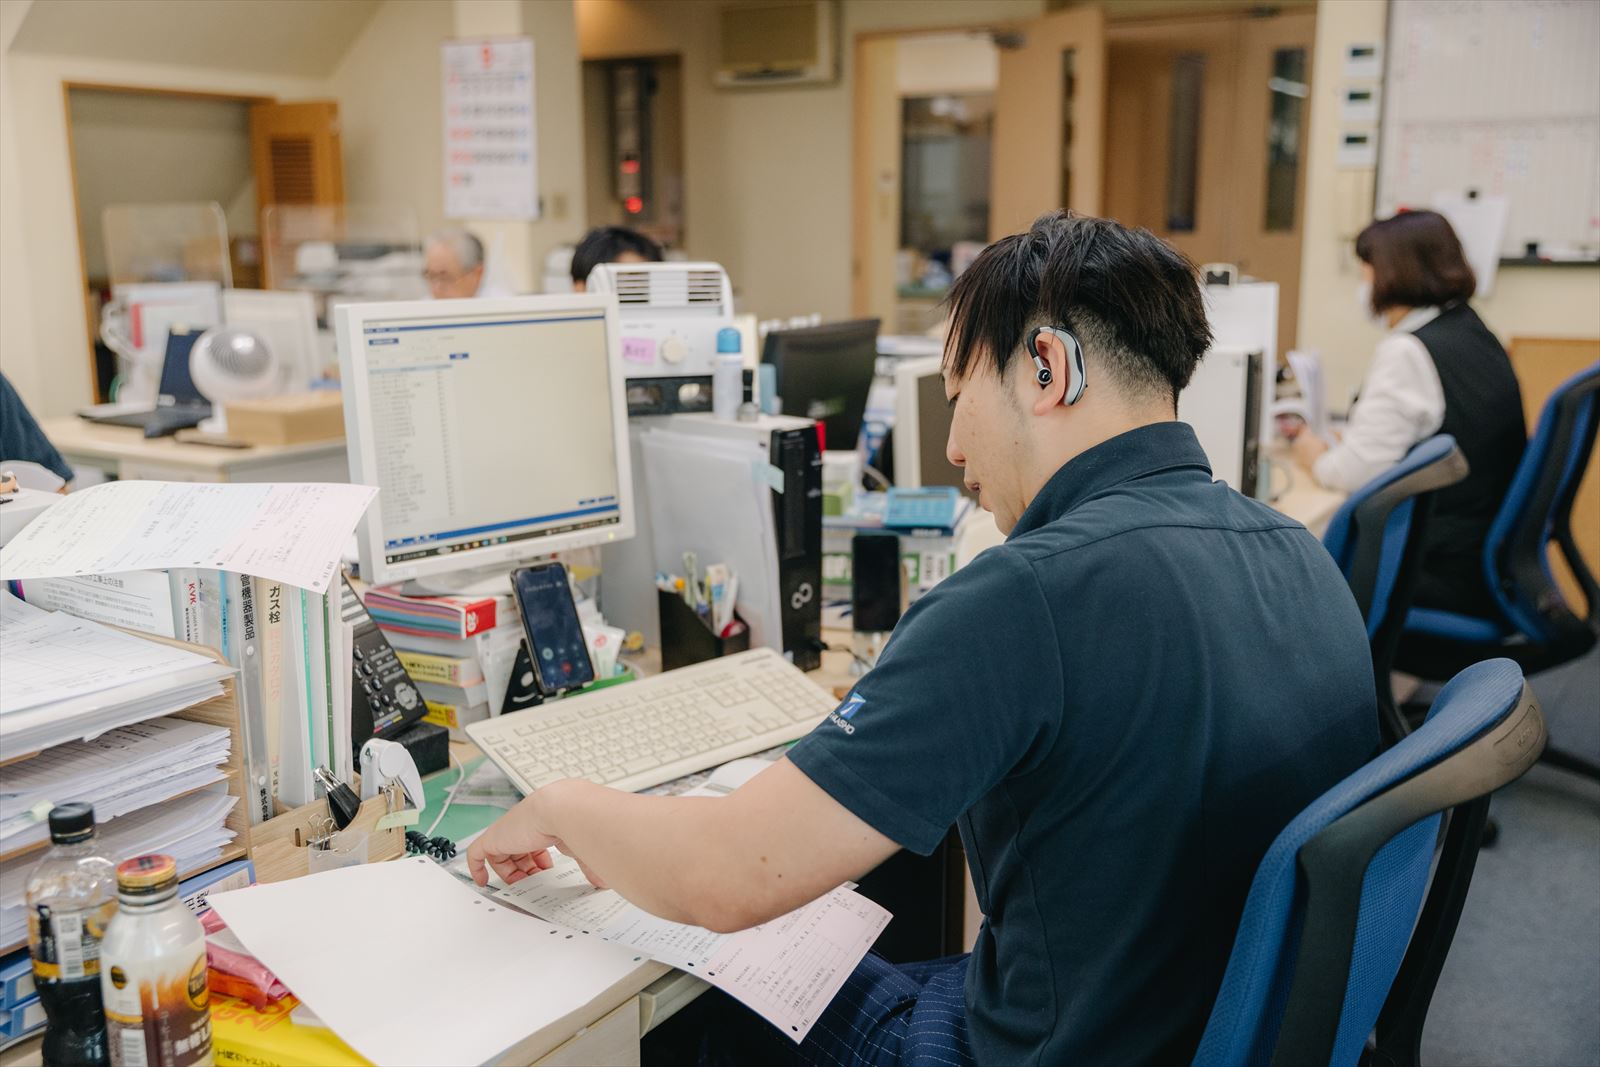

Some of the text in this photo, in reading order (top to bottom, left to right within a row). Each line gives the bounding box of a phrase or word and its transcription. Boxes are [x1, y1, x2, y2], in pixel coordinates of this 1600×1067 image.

[187, 582, 198, 606] KVK
[269, 584, 281, 624] ガス栓
[260, 787, 269, 822] 株式会社
